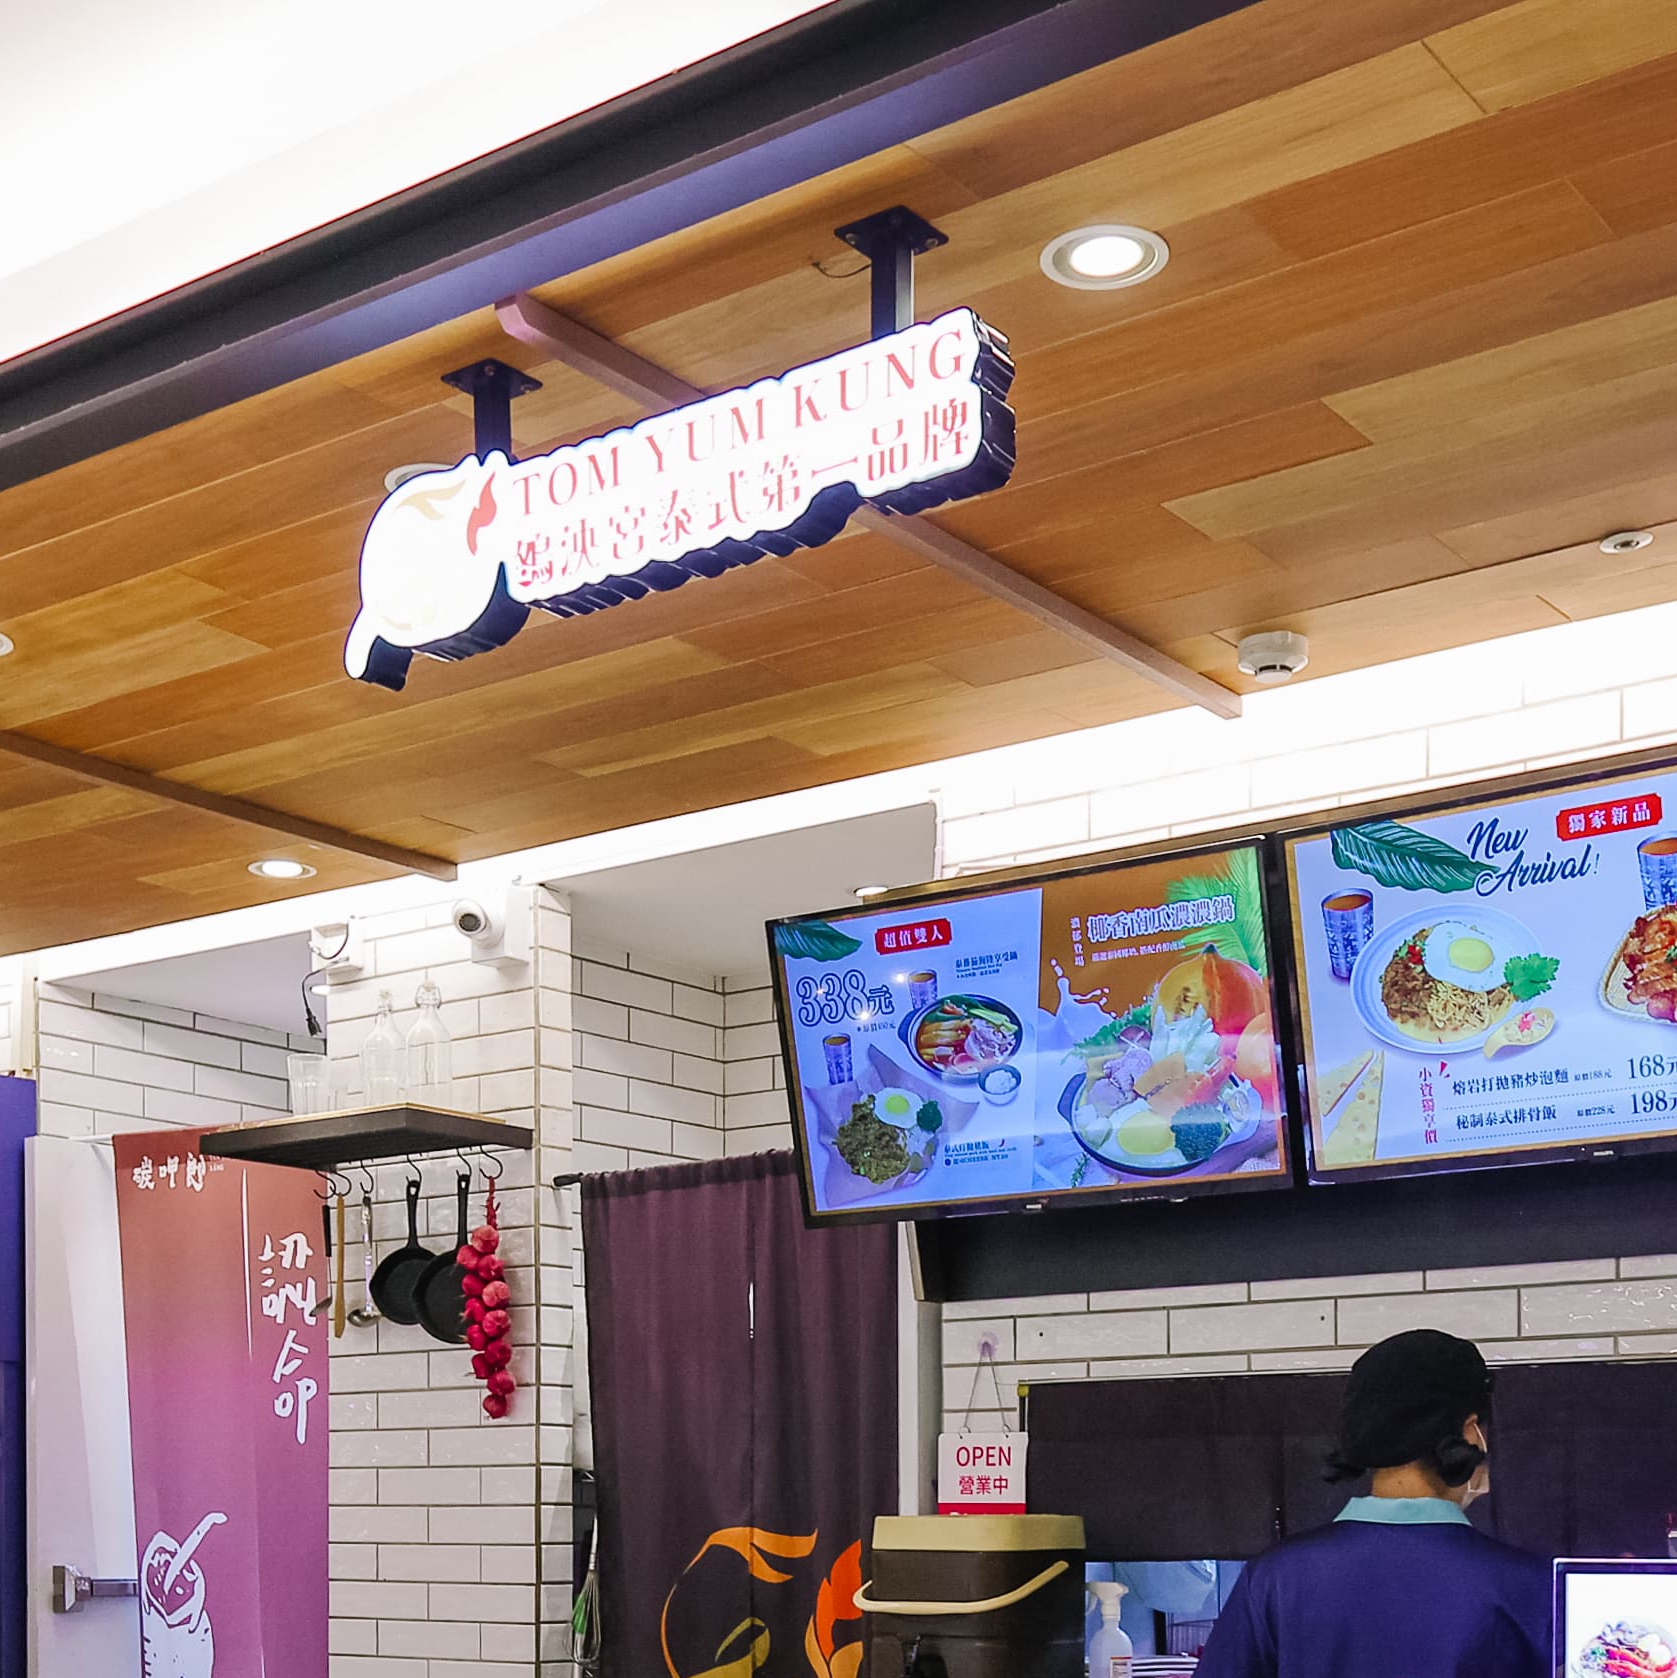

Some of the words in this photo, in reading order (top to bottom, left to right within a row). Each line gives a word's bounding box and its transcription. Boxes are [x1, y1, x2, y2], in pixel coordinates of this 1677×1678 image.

[513, 460, 621, 517] TOM
[644, 397, 769, 472] YUM
[793, 329, 966, 430] KUNG
[1568, 800, 1651, 833] 獨家新品
[1467, 817, 1529, 860] New
[883, 924, 944, 949] 超值雙人
[796, 968, 896, 1028] 338元
[1419, 1067, 1438, 1144] 小資獨享價
[956, 1445, 1012, 1468] OPEN
[959, 1474, 1009, 1496] 營業中
